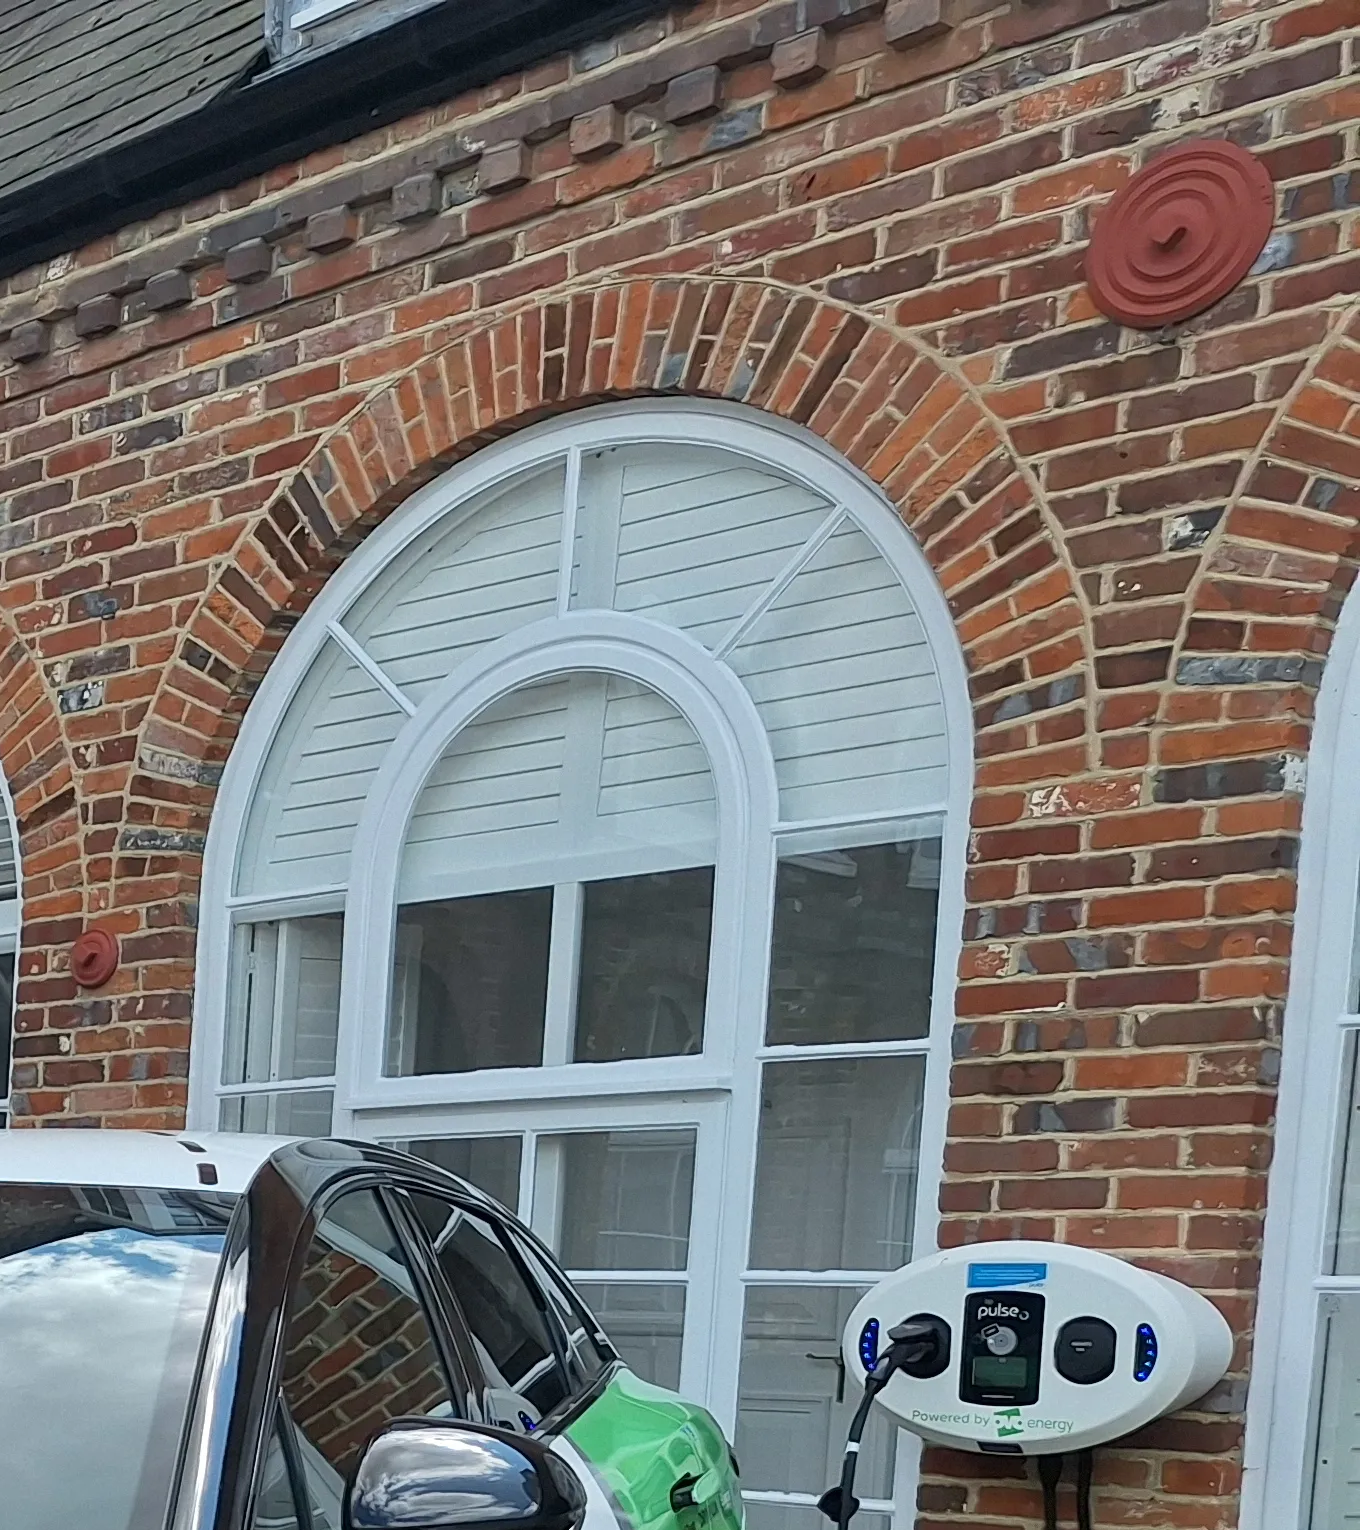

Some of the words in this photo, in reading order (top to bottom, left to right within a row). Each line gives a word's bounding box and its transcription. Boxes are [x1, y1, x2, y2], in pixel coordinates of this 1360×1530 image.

[977, 1303, 1020, 1320] pulse
[911, 1409, 970, 1424] Powered
[974, 1413, 990, 1427] by
[1027, 1418, 1074, 1432] energy
